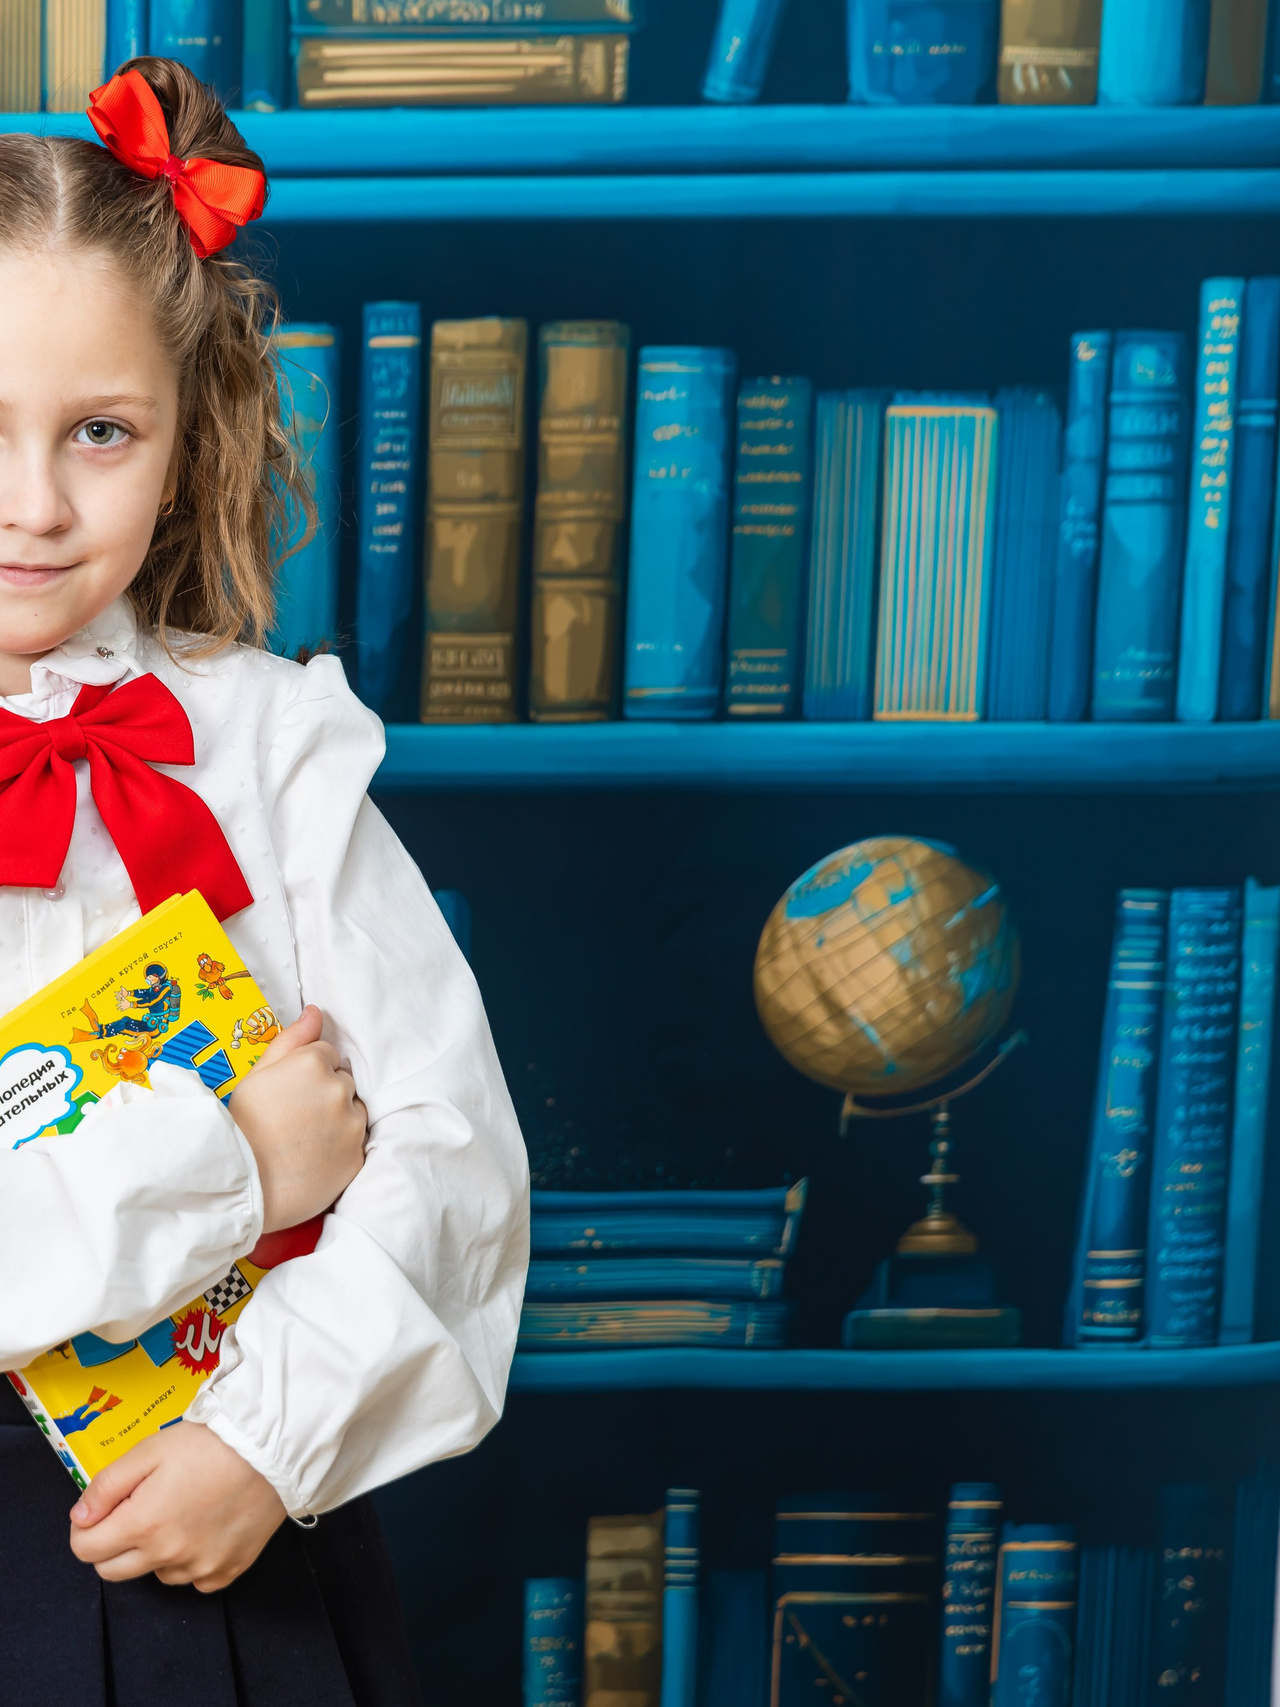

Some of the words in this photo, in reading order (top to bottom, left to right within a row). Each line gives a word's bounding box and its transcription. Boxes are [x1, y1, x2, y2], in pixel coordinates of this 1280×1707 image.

[60, 1006, 77, 1019] Где
[91, 977, 116, 999] самый
[118, 952, 150, 977] крутой
[153, 931, 184, 954] спуск?
[99, 1436, 115, 1447] Что
[118, 1418, 141, 1437] такое
[143, 1385, 176, 1417] акведук?
